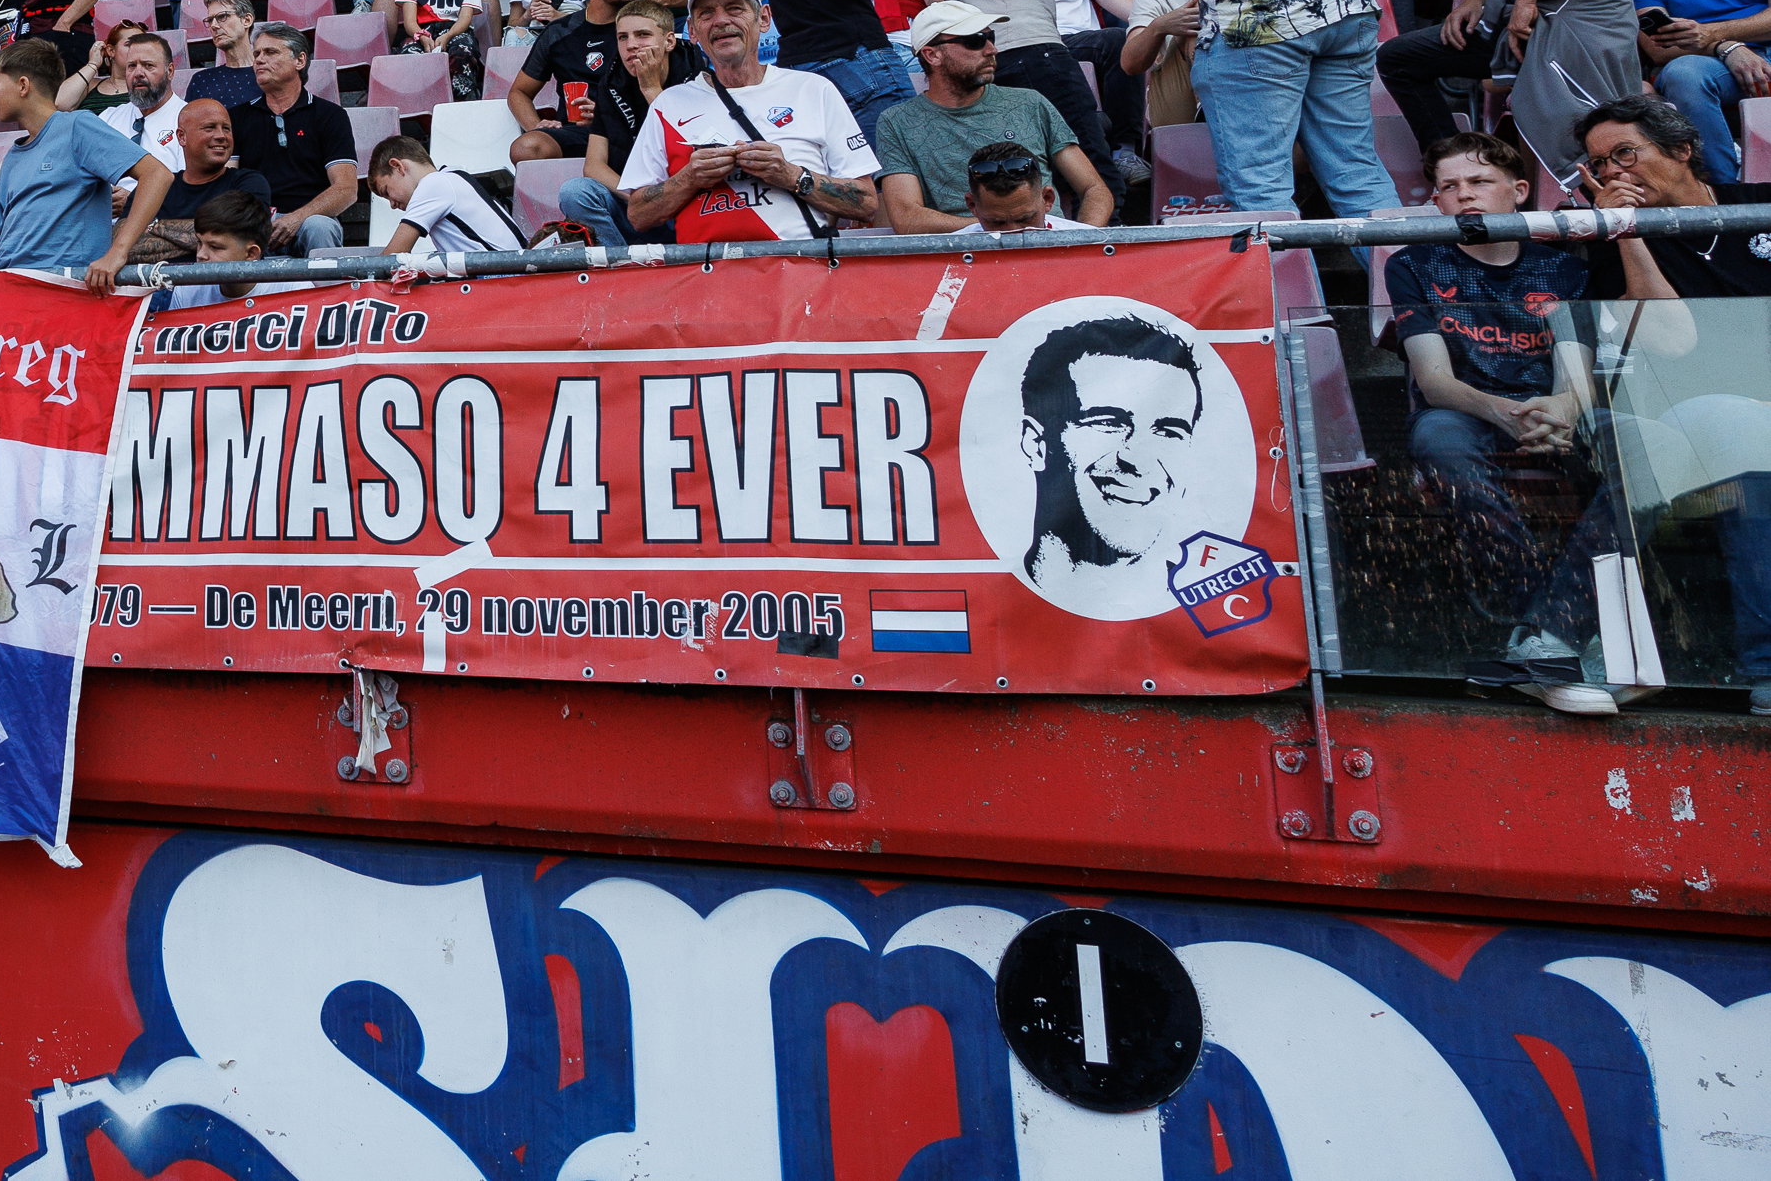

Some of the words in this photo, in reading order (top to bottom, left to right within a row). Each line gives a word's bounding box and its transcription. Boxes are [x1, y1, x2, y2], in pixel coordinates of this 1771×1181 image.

[700, 184, 773, 216] Zaak
[153, 304, 303, 355] merci
[314, 298, 429, 353] DiTo
[107, 373, 505, 545] MMASO
[534, 373, 611, 545] 4
[640, 367, 940, 546] EVER
[25, 518, 79, 596] L
[1180, 555, 1268, 607] UTRECHT
[1199, 544, 1220, 569] F
[90, 582, 143, 627] 79
[203, 584, 256, 629] De
[265, 585, 405, 638] Meern,
[417, 587, 472, 635] 29
[482, 588, 712, 641] november
[721, 590, 845, 642] 2005
[1223, 593, 1250, 621] C
